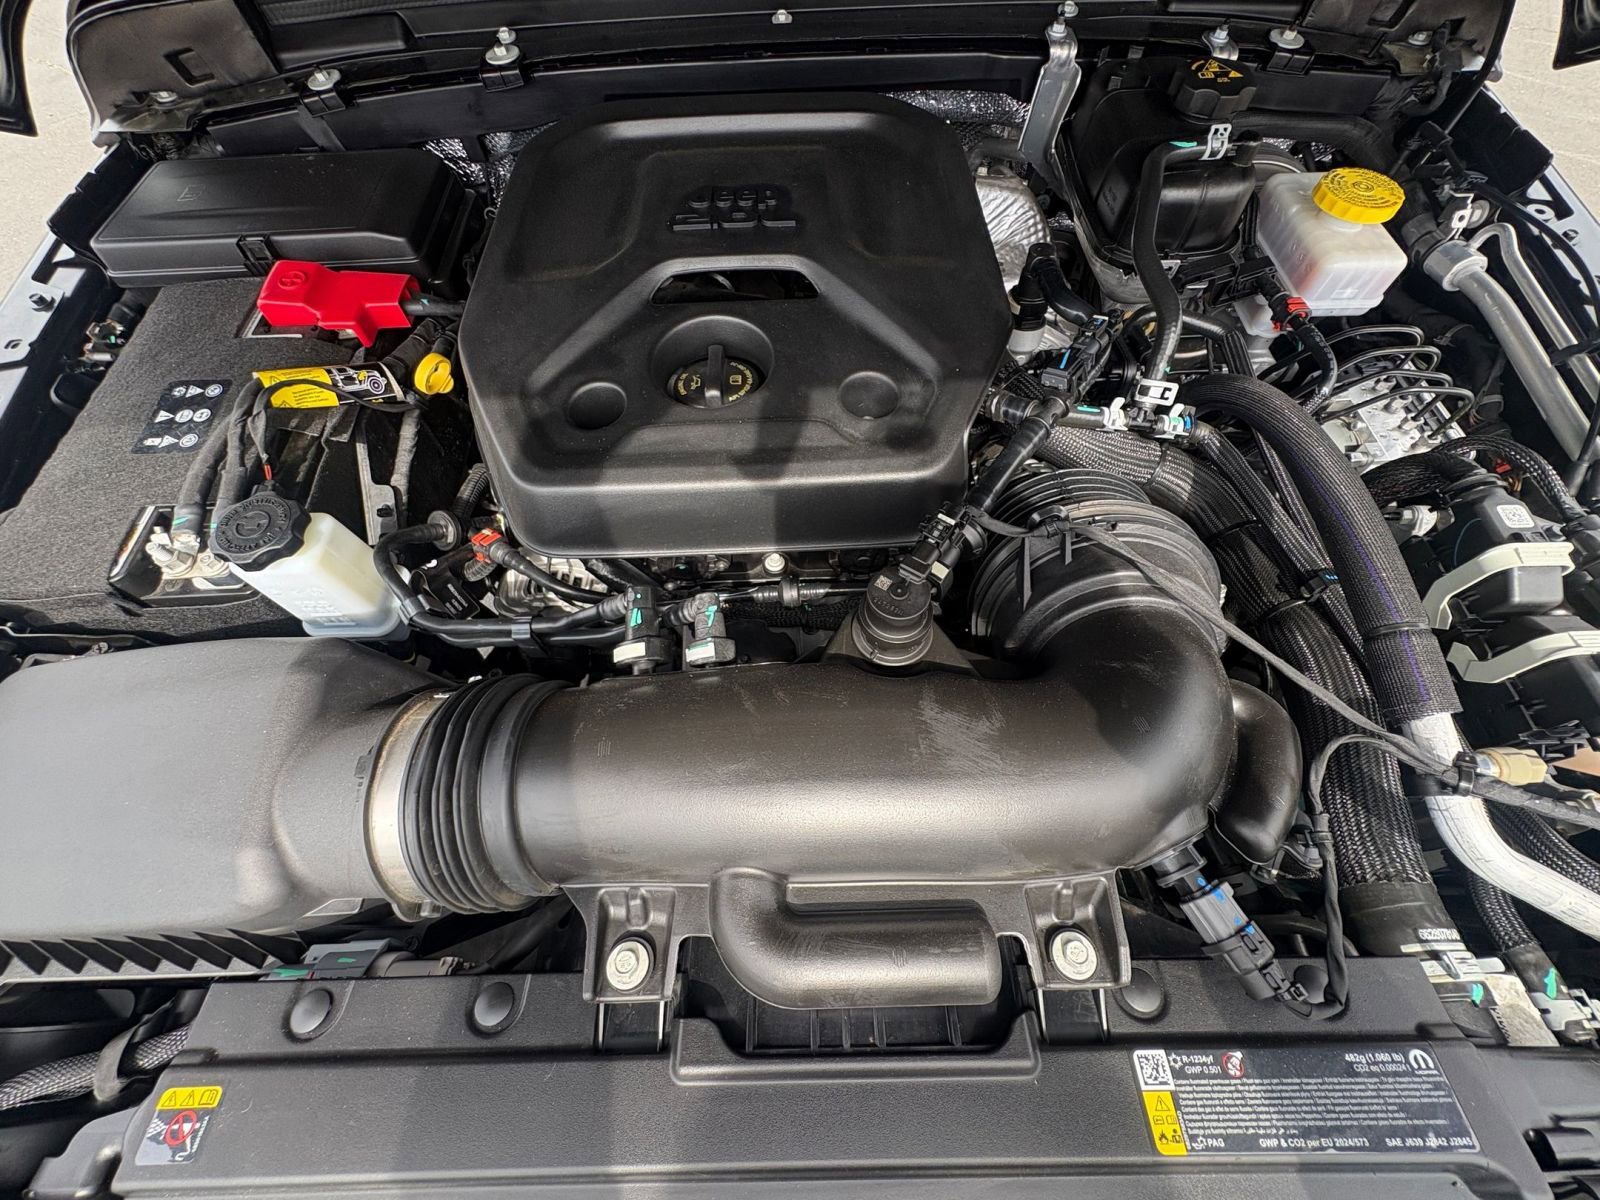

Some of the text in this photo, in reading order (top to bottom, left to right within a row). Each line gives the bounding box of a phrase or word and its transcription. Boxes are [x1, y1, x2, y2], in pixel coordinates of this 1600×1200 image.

[1185, 1065, 1203, 1074] GWP
[1208, 1138, 1225, 1147] PAG
[1259, 1138, 1279, 1148] GWP
[1280, 1139, 1287, 1147] &
[1288, 1138, 1306, 1147] CO2
[1306, 1140, 1320, 1148] per
[1321, 1138, 1334, 1147] EU
[1385, 1137, 1404, 1147] SAE
